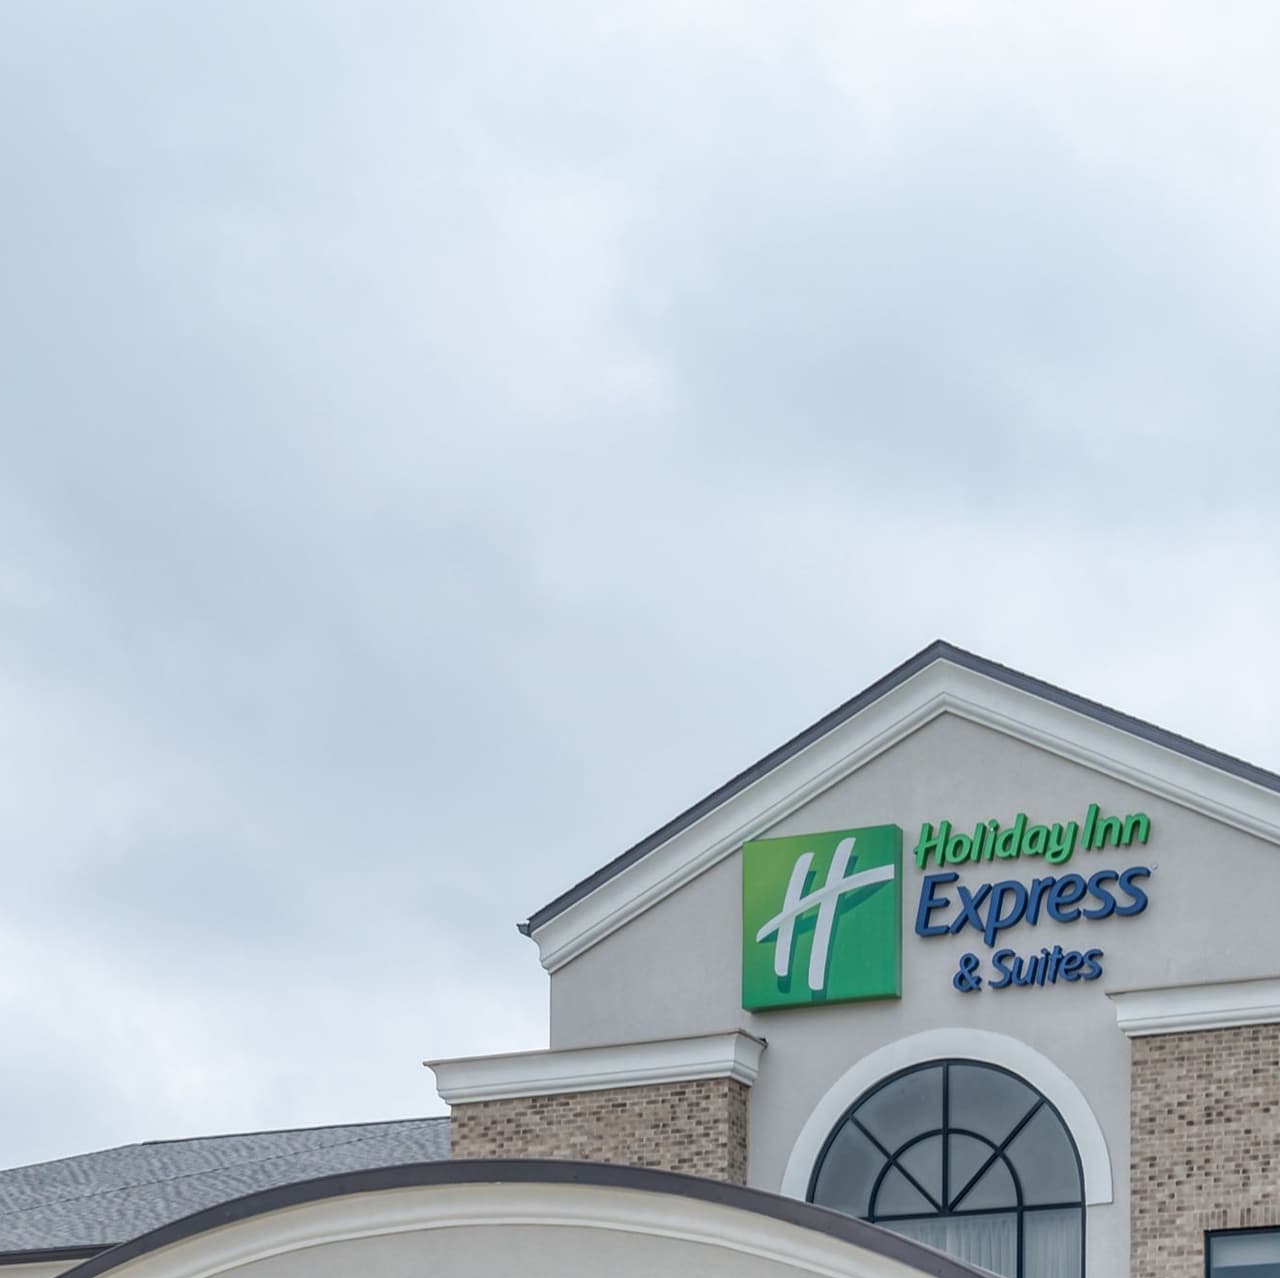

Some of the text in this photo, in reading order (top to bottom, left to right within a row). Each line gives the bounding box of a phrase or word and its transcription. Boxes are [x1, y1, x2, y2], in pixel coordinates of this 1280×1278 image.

[914, 803, 1151, 869] Holiday Inn
[756, 837, 895, 991] H
[915, 866, 1151, 947] Express
[953, 945, 1103, 993] & Suites
